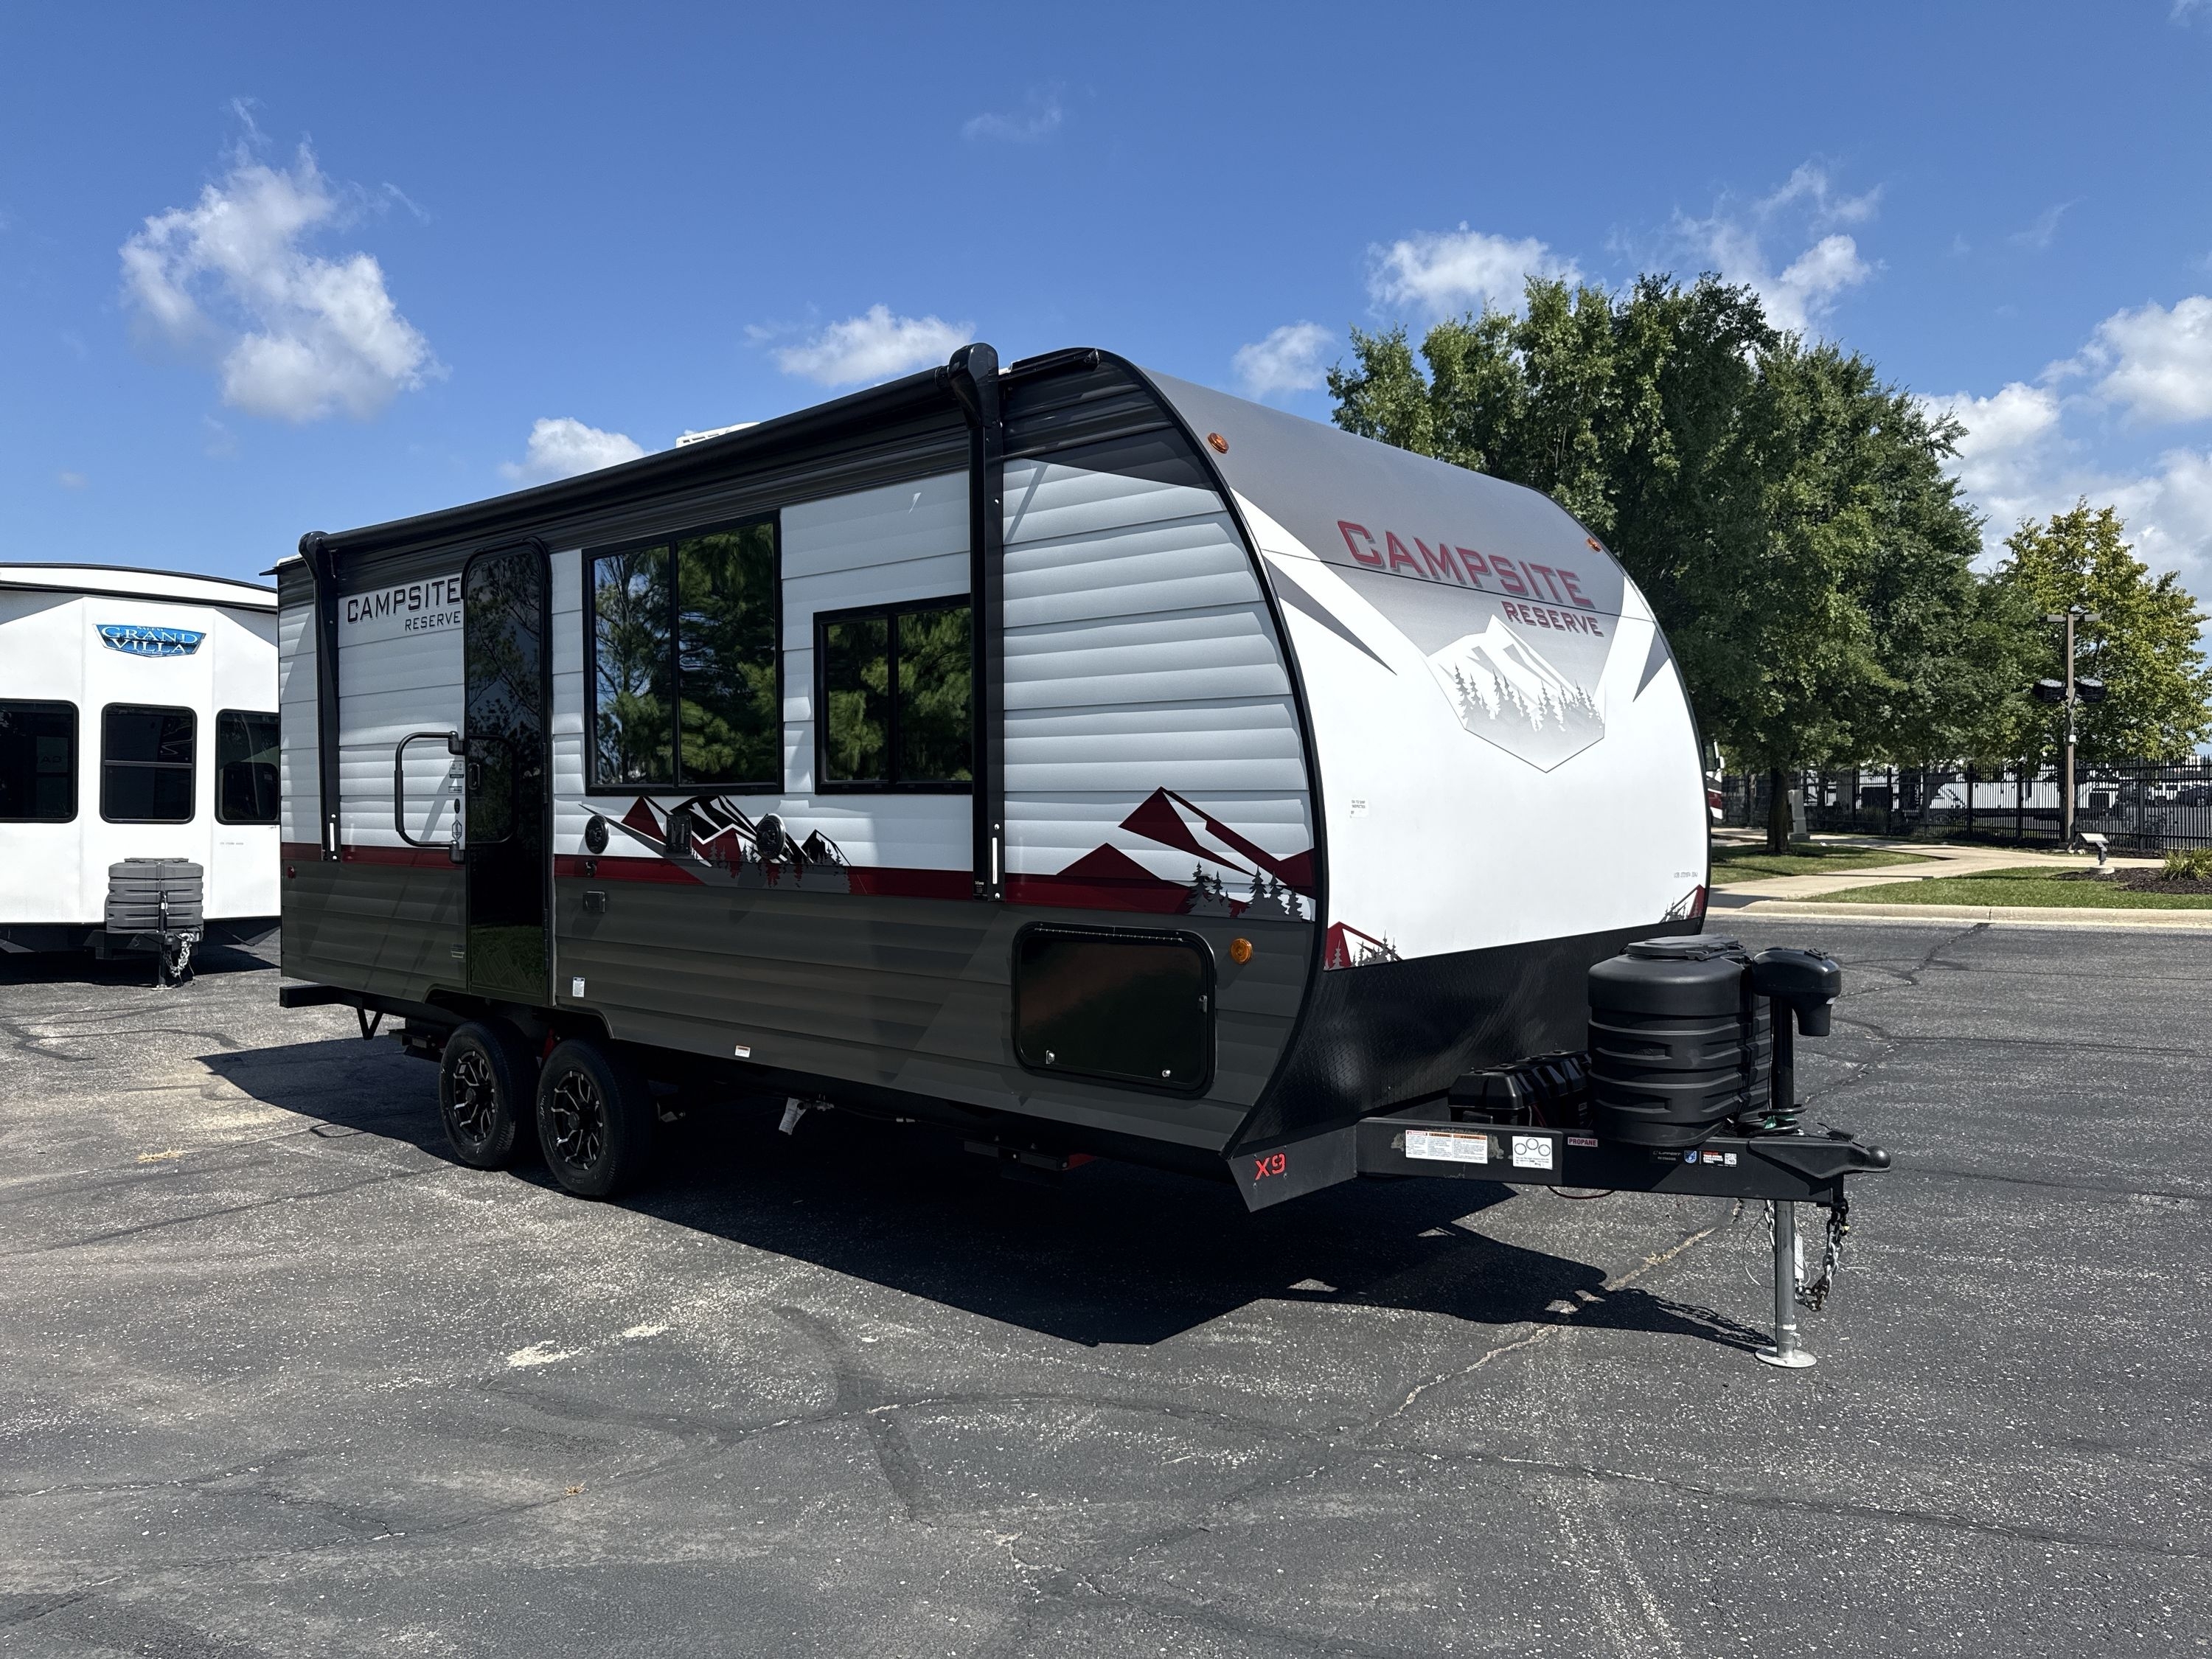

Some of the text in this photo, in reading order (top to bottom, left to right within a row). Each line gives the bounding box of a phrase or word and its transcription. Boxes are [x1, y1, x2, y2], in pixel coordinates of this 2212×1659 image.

[1338, 521, 1596, 610] CAMPSITE
[347, 577, 461, 625] CAMPSITE
[405, 611, 461, 631] RESERVE
[1501, 600, 1604, 637] RESERVE
[101, 626, 198, 644] GRAND
[111, 638, 187, 653] VILLA
[1568, 1138, 1597, 1147] PROPANE
[1255, 1152, 1286, 1180] X9
